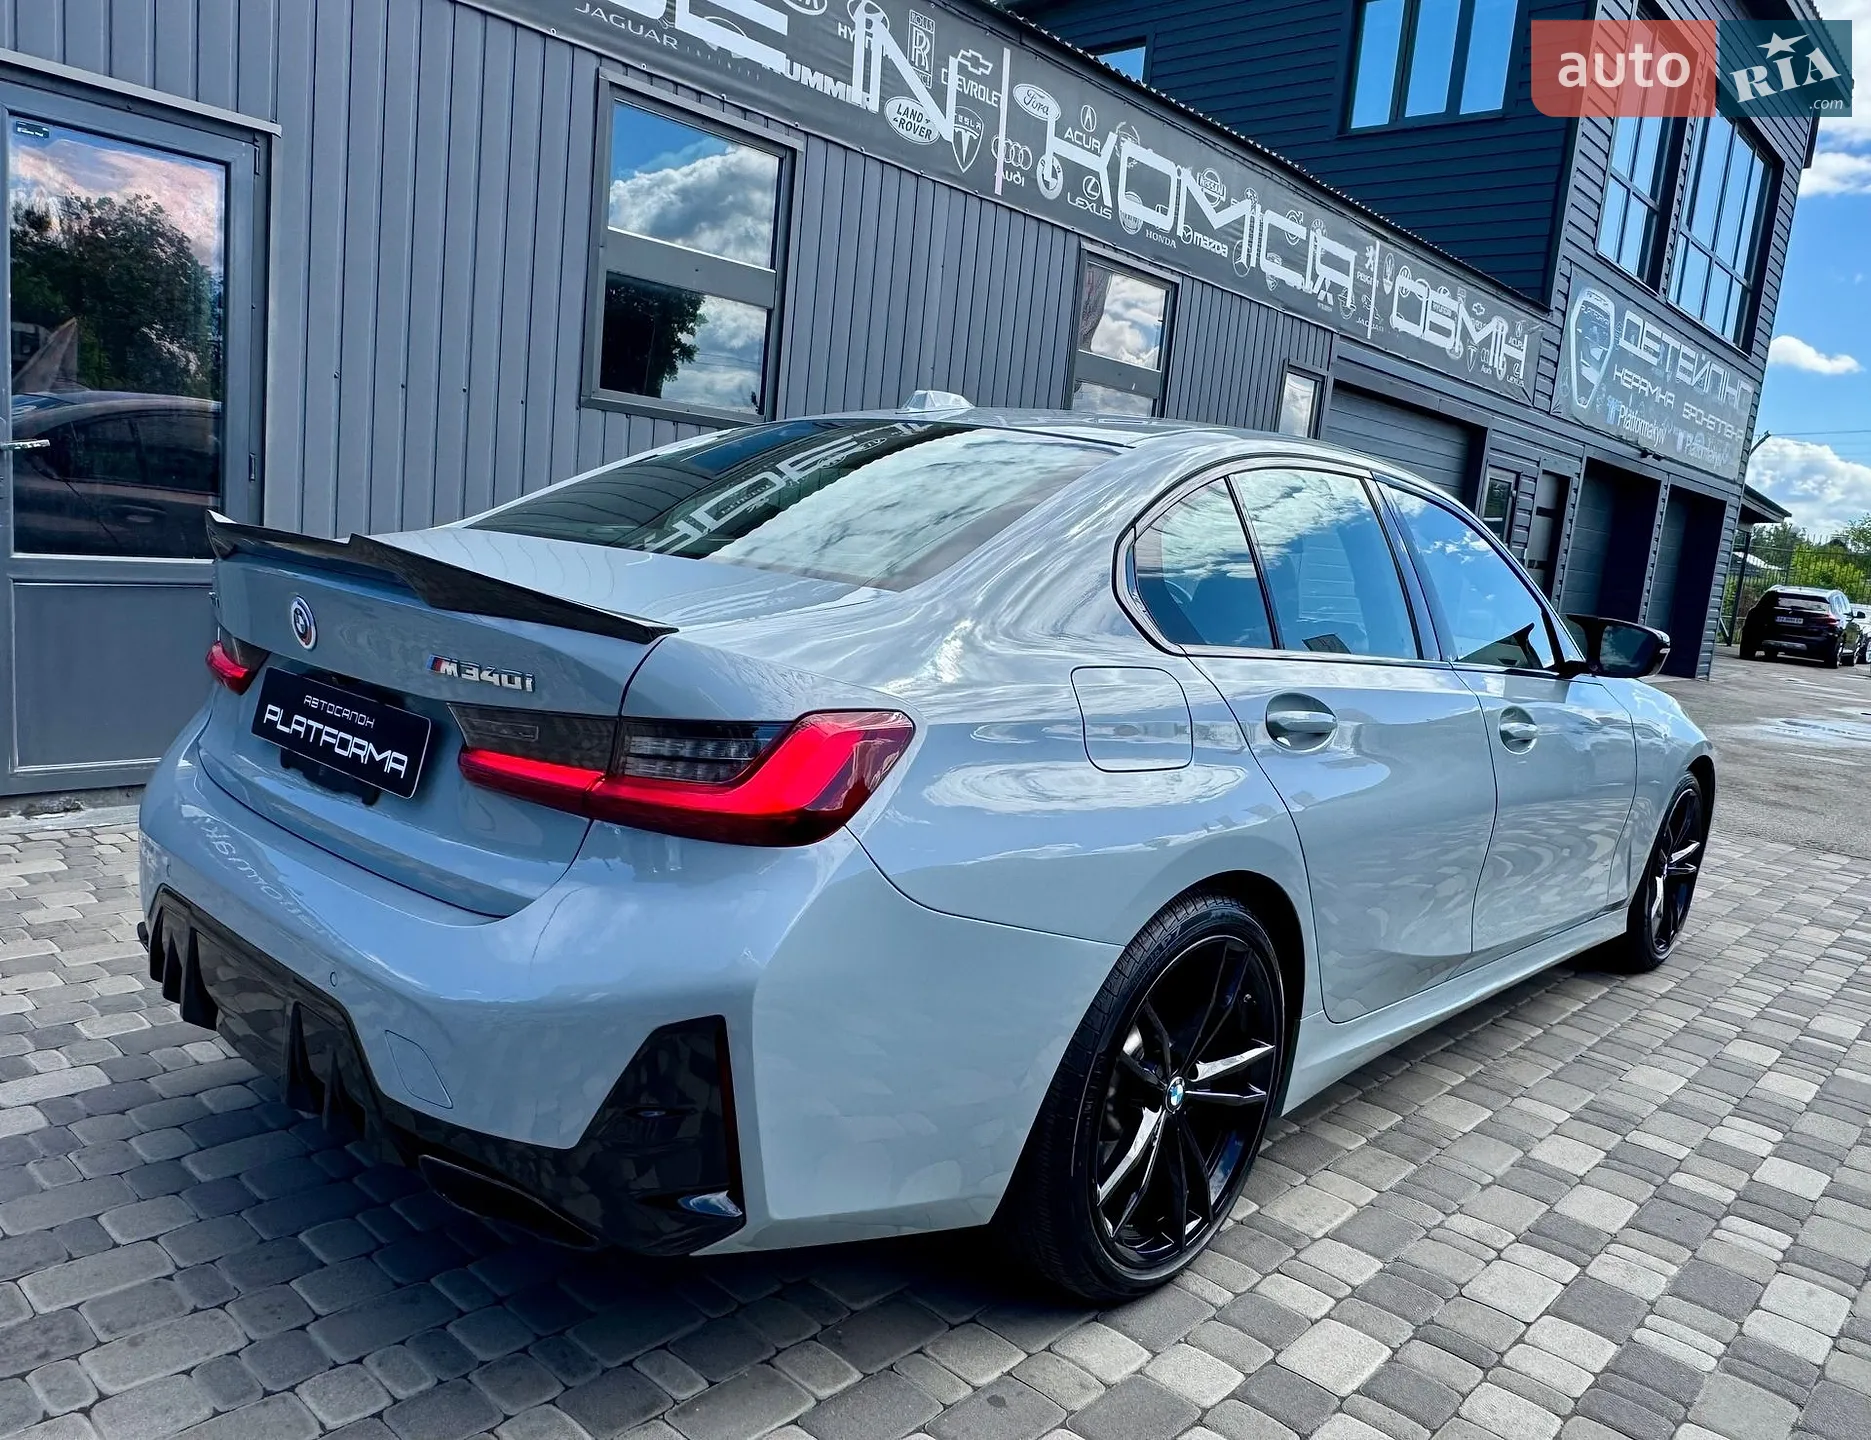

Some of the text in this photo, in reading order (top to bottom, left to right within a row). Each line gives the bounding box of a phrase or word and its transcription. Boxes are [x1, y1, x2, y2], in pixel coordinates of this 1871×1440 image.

[574, 3, 678, 50] JAGUAR
[941, 68, 1002, 108] CEVROLE
[896, 103, 924, 123] LAND
[955, 112, 982, 131] ESLA
[898, 118, 933, 141] ROVER
[1064, 127, 1101, 154] ACUR
[995, 169, 1025, 188] udi
[1067, 192, 1113, 220] LEXUS
[1145, 229, 1177, 249] HONDA
[436, 656, 534, 692] M340i
[303, 694, 376, 729] АВТОСАЛОН
[263, 703, 408, 779] PLATFORMA
